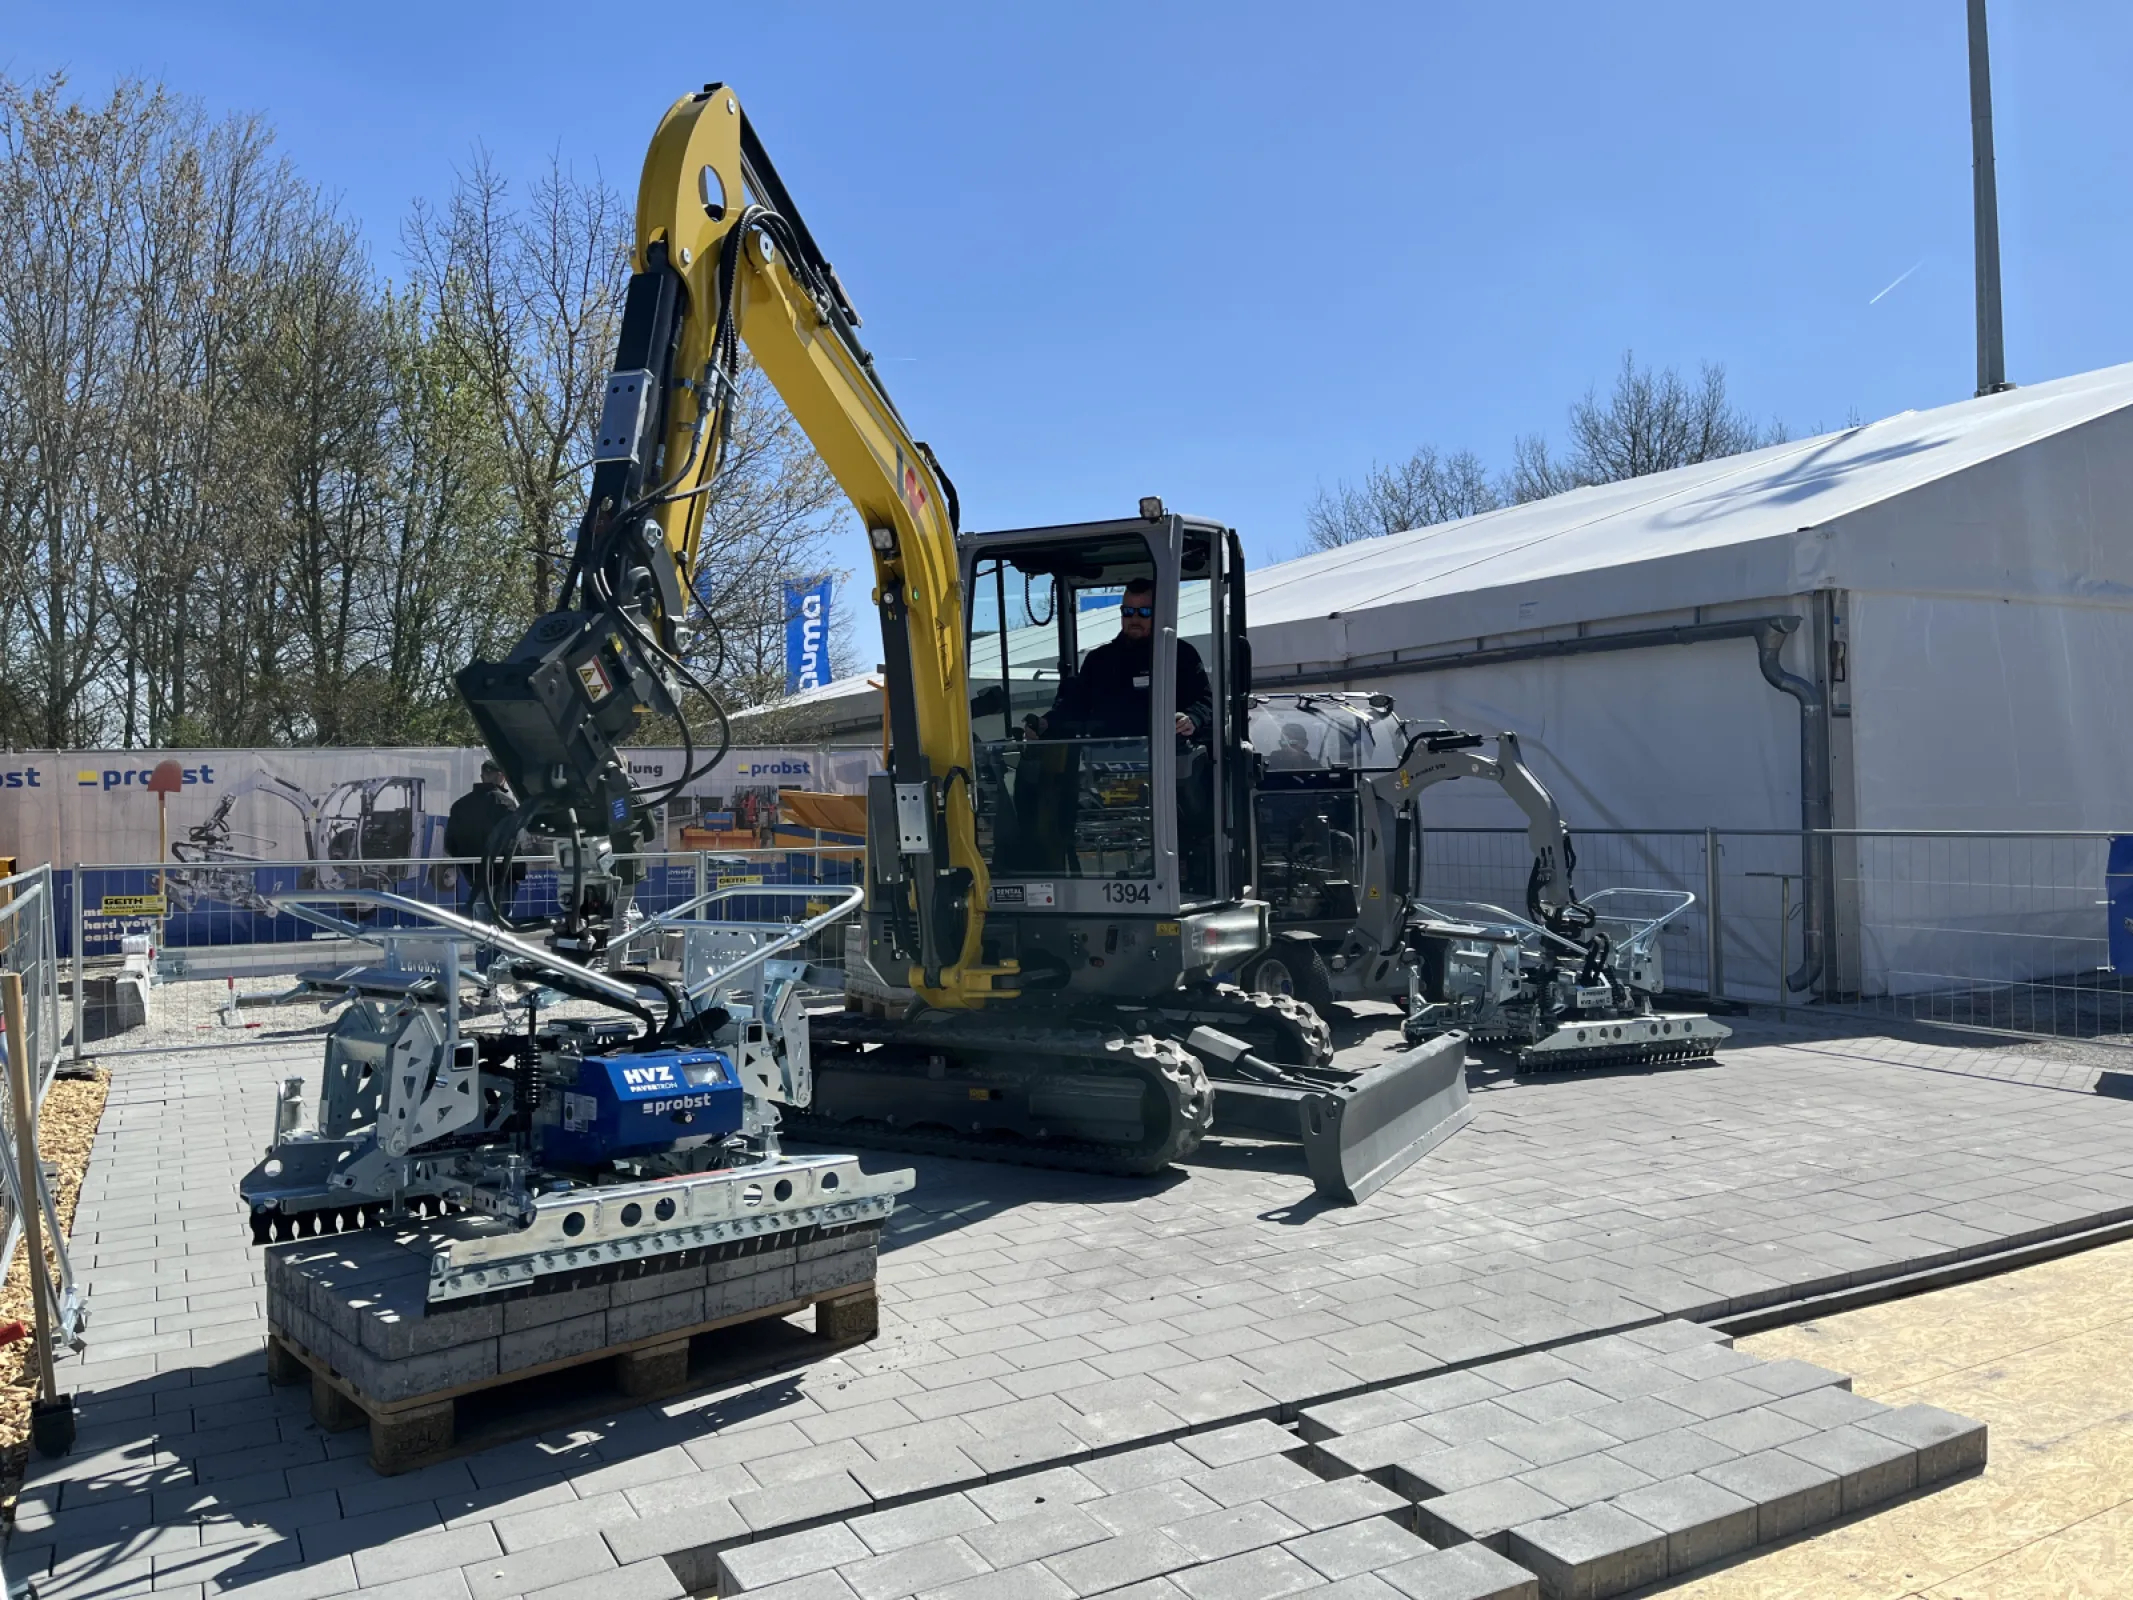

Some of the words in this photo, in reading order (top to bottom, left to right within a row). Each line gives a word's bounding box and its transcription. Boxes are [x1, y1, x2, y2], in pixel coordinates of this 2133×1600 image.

[799, 595, 821, 688] auma
[0, 767, 41, 788] st
[103, 764, 214, 791] prost
[628, 761, 664, 777] lung
[752, 761, 811, 777] probst
[1102, 882, 1151, 904] 1394
[84, 918, 117, 930] hard
[84, 931, 122, 942] easie
[623, 1066, 674, 1085] HVZ
[655, 1093, 712, 1116] probst
